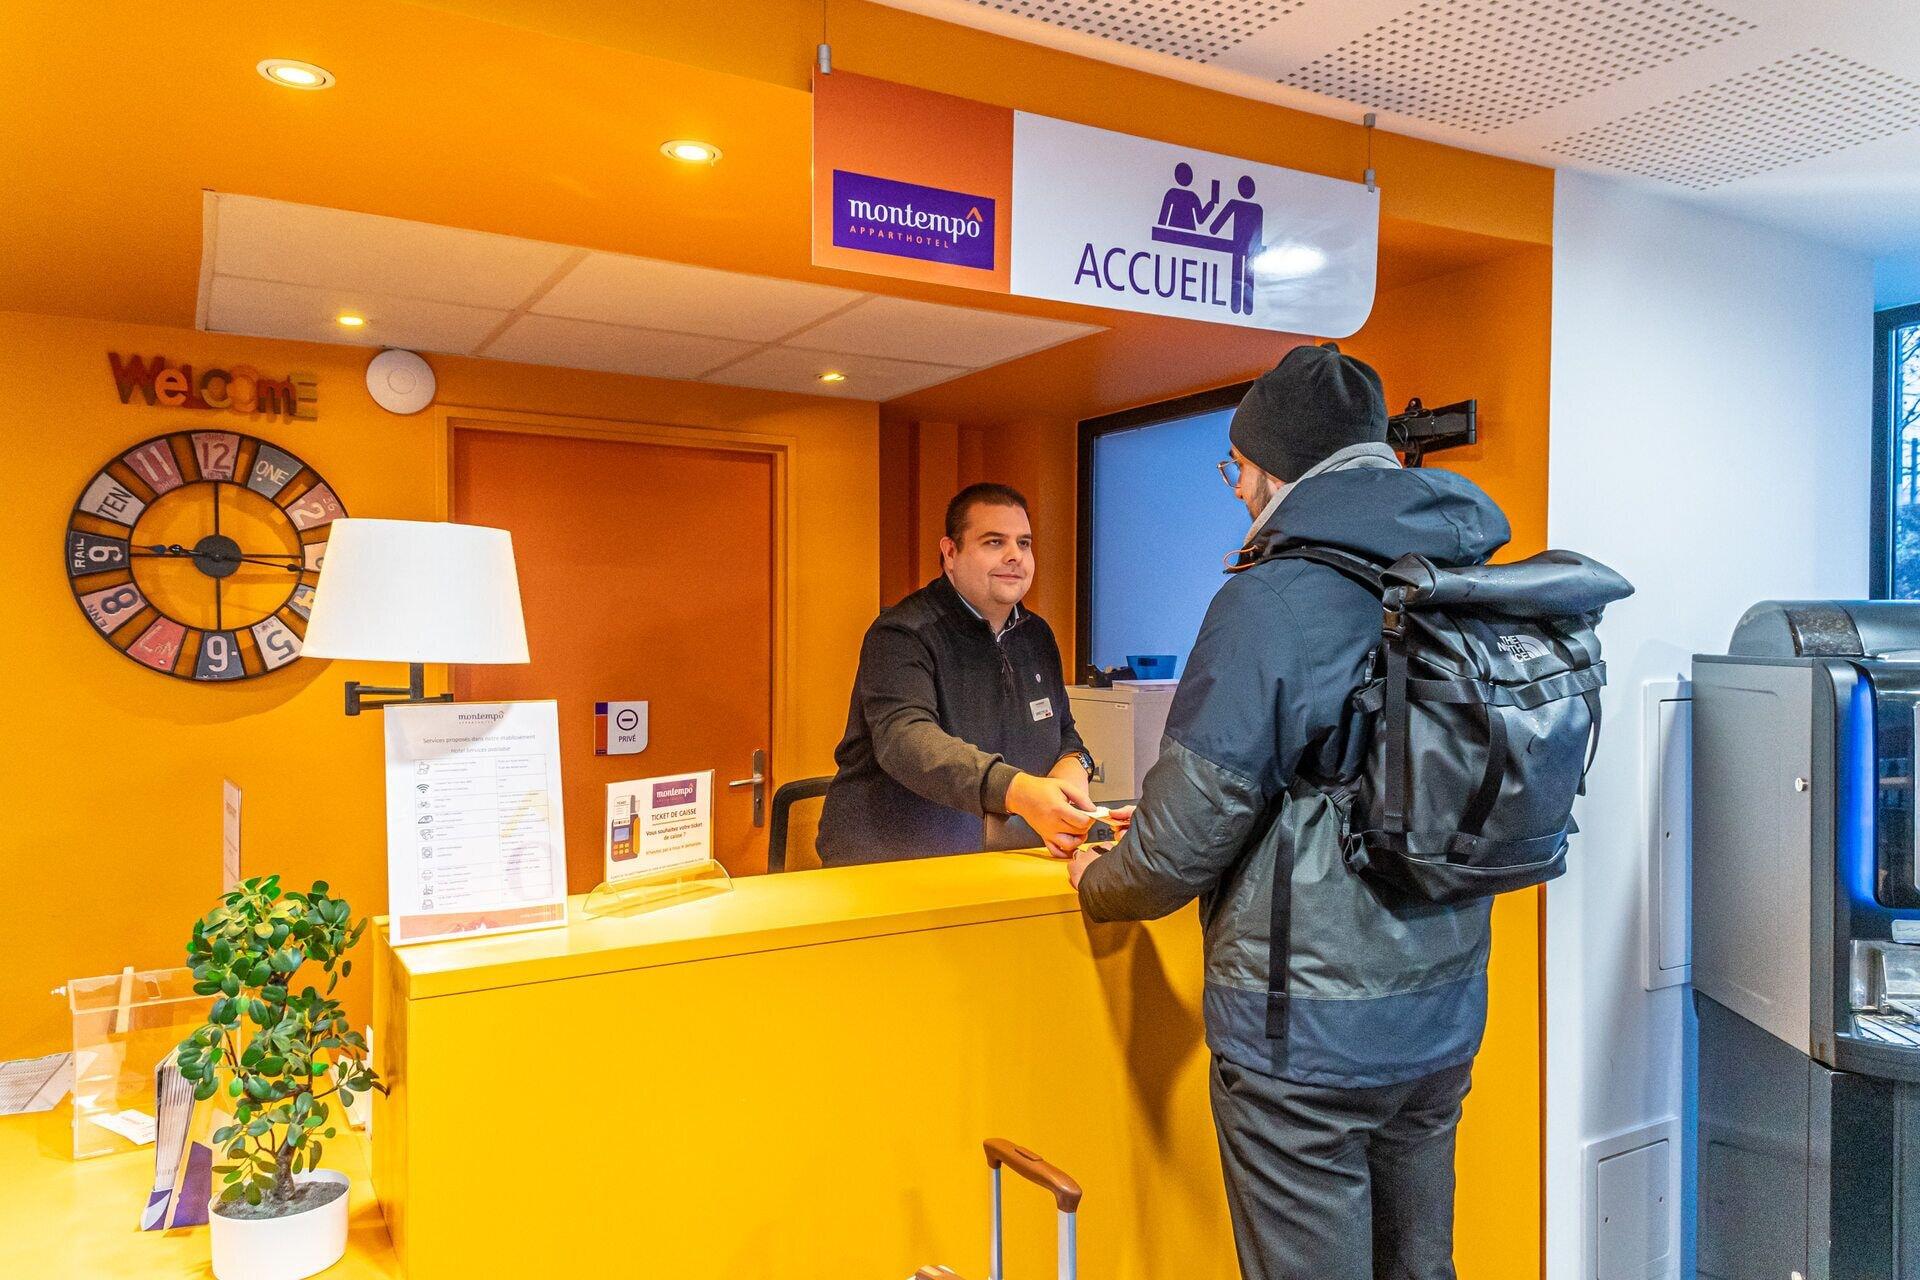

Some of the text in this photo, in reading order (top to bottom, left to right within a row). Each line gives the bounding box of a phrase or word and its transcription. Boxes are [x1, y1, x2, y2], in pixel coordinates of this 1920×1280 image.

[848, 199, 983, 243] montempô
[849, 225, 949, 249] APPARTHOTEL
[1074, 242, 1227, 306] ACCUEIL
[136, 445, 173, 482] 11
[201, 442, 231, 470] 12
[255, 460, 290, 487] ONE
[96, 486, 133, 519] TEN
[291, 501, 326, 527] 2
[74, 538, 86, 568] RAIL
[101, 588, 138, 615] 8
[266, 629, 296, 661] 5
[1499, 635, 1520, 644] THE
[458, 710, 505, 722] montempô
[618, 734, 637, 743] PRIVÉ
[656, 782, 694, 798] montempô
[651, 808, 697, 821] TICKET DE CAISSE
